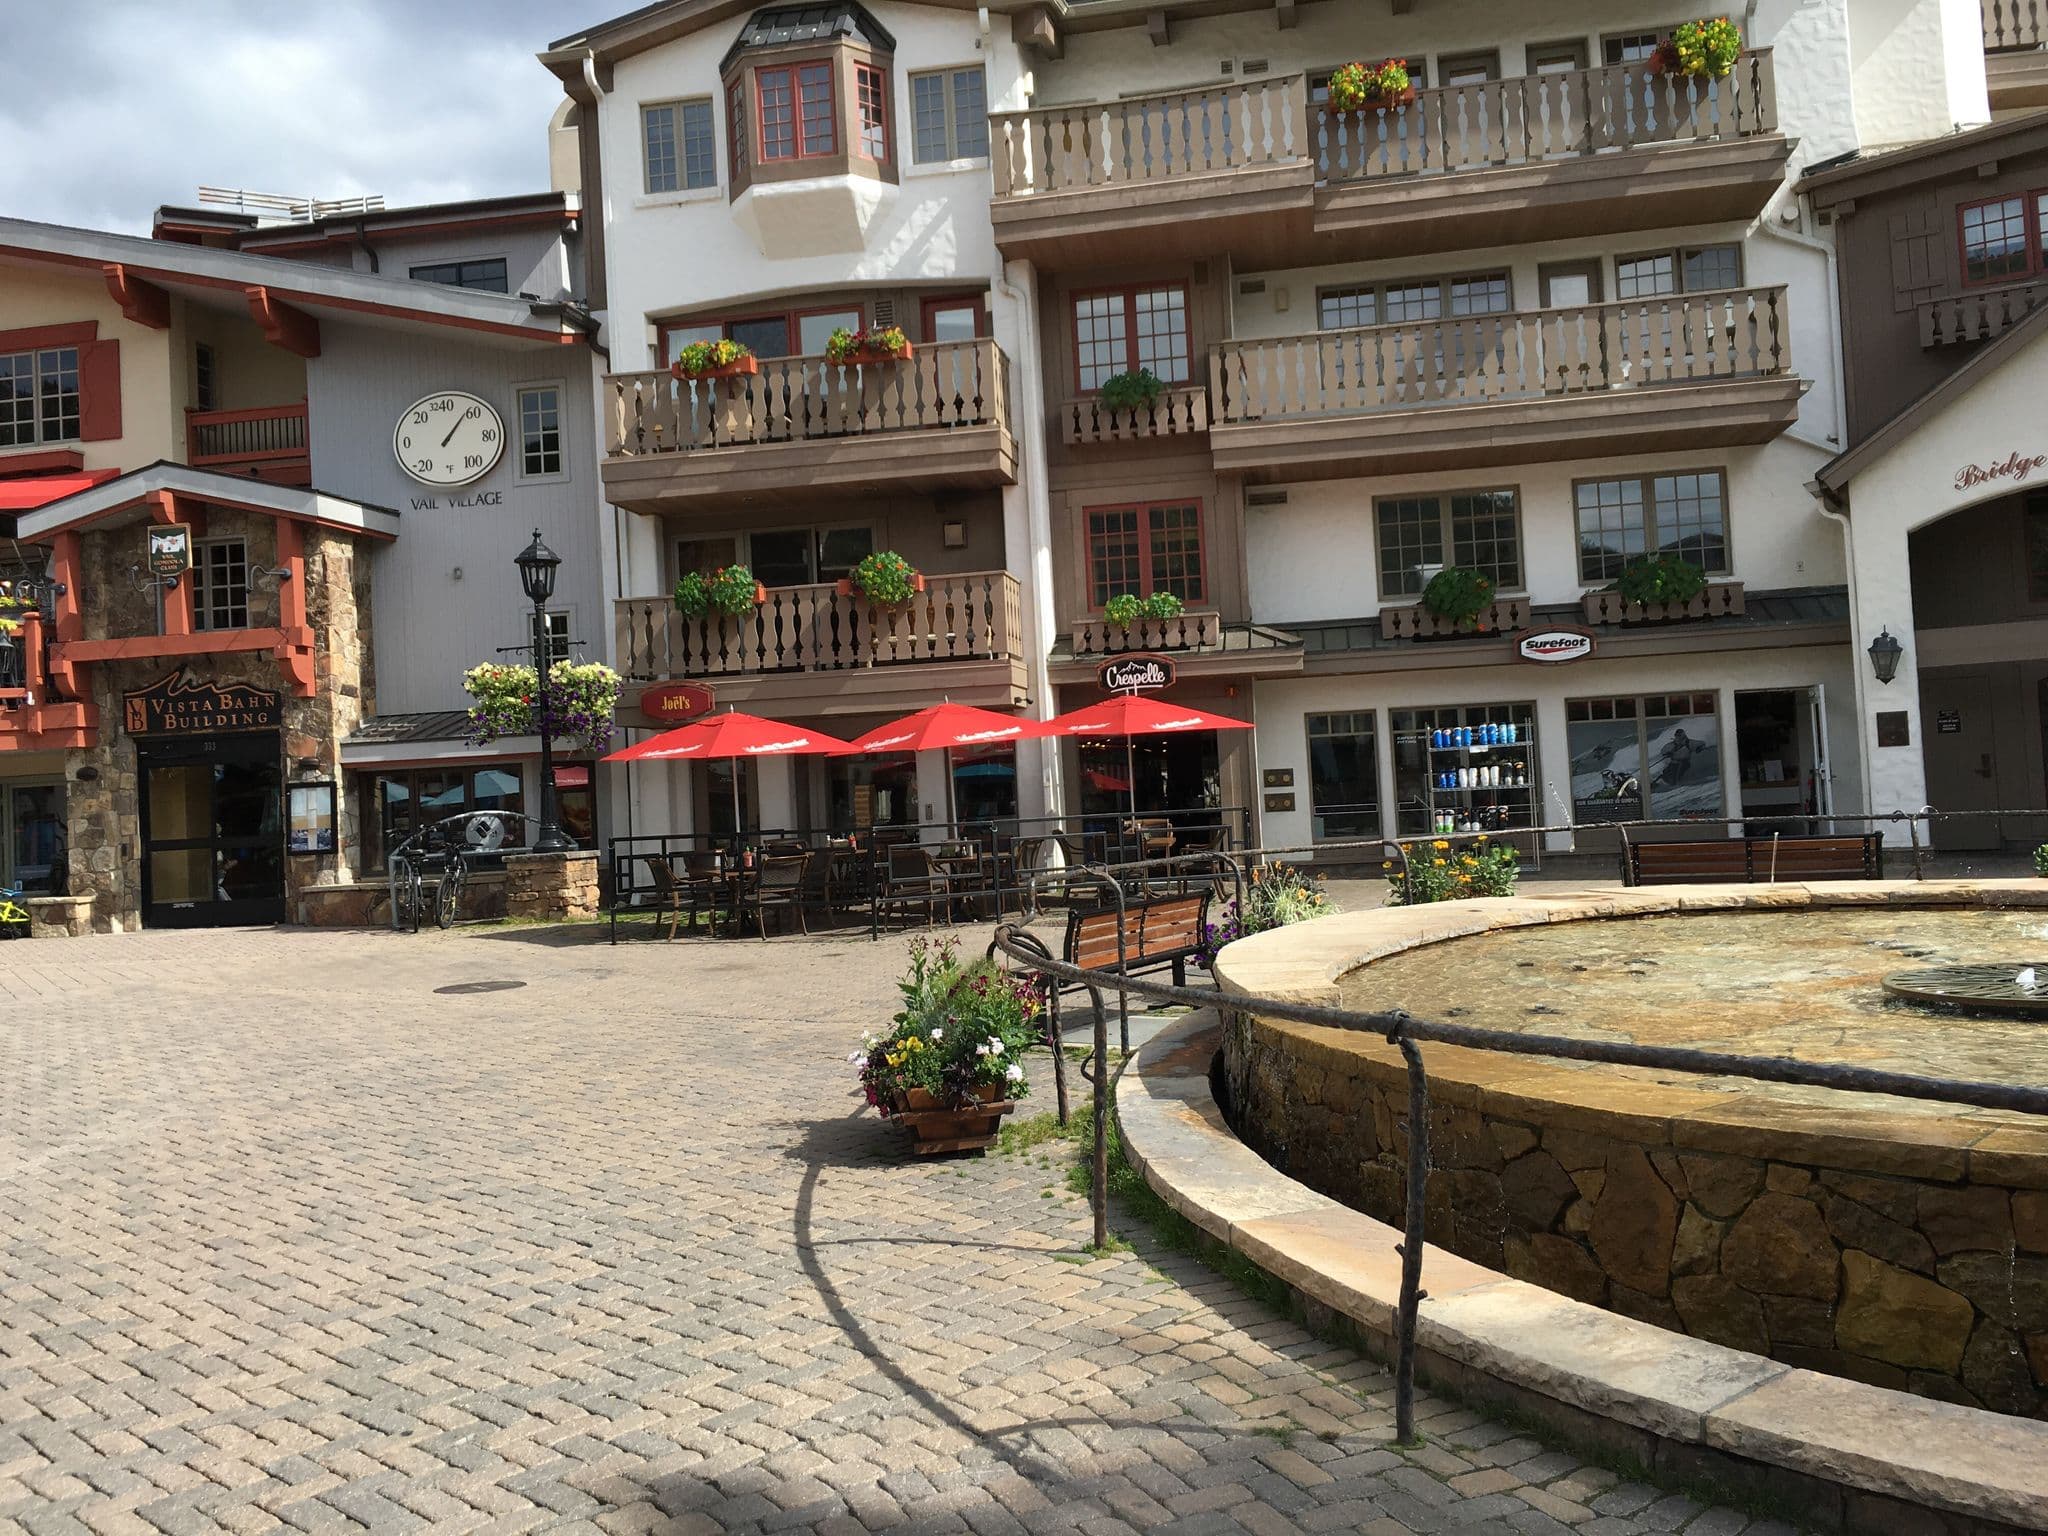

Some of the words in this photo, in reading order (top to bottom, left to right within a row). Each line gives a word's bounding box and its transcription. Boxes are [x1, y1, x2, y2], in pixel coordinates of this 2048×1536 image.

[438, 399, 454, 412] 40
[413, 411, 428, 424] 20
[465, 407, 481, 419] 60
[482, 429, 496, 442] 80
[403, 436, 411, 449] 0
[412, 459, 433, 472] -20
[464, 455, 483, 469] 100
[1954, 450, 2047, 491] Bridge
[411, 497, 439, 510] VAIL
[448, 491, 502, 508] VILLAGE
[1525, 638, 1587, 649] Surefoot
[1106, 662, 1166, 694] Crespelle
[151, 698, 213, 715] VISTA
[219, 693, 275, 710] BAHN
[661, 695, 691, 711] Joël's
[164, 712, 268, 730] BUILDING
